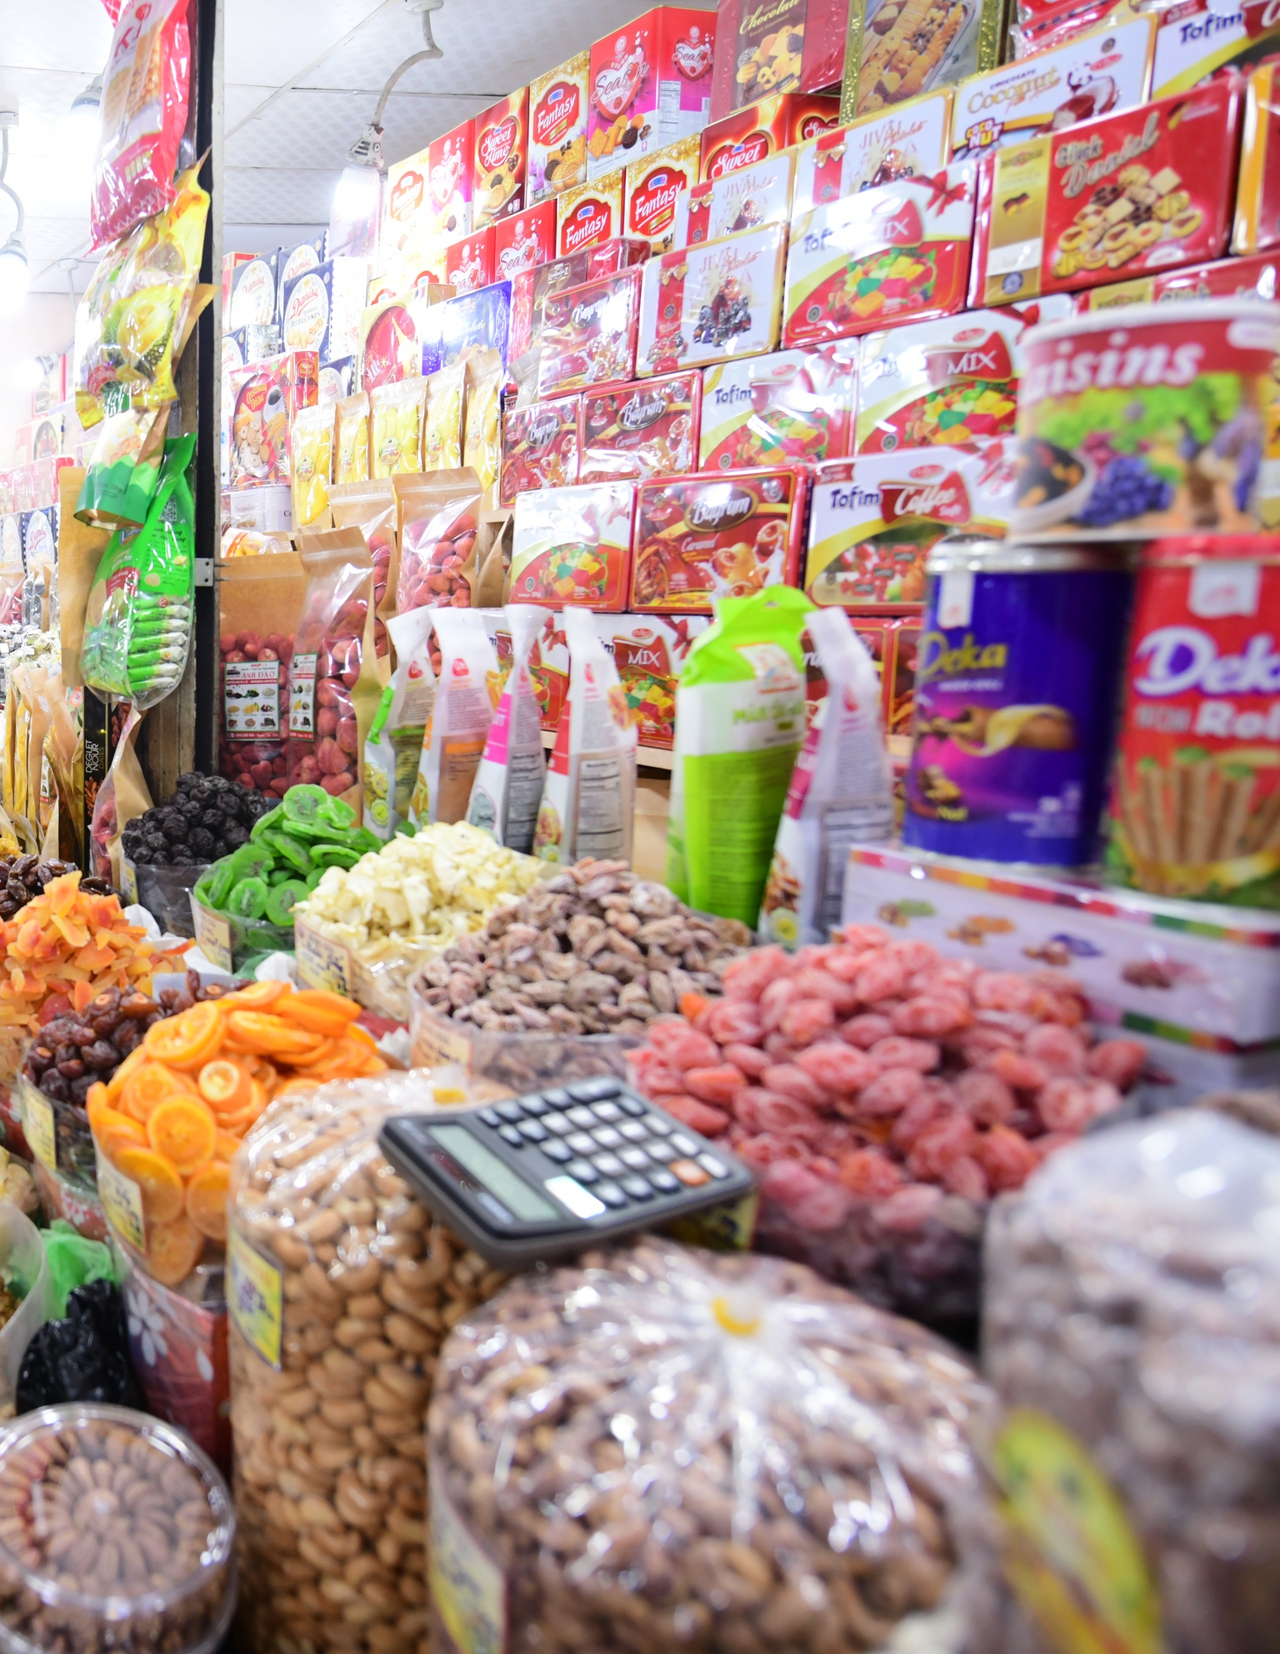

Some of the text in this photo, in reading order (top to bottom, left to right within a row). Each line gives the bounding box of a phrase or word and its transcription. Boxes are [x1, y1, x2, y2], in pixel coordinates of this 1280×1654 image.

[1180, 11, 1243, 45] Tofim
[967, 66, 1062, 115] Coconut
[990, 69, 1036, 90] CHOCOLATE
[537, 92, 577, 128] Fantasy
[482, 124, 513, 156] Sweet
[966, 119, 996, 141] COCO
[968, 123, 1005, 150] NUT
[483, 143, 511, 166] Time
[711, 143, 762, 179] Sweet
[1055, 134, 1104, 168] Glück
[635, 181, 682, 220] Fantasy
[565, 211, 609, 248] Fantasy
[804, 230, 835, 253] Tof
[292, 289, 320, 319] Danisa
[946, 350, 998, 376] MIX
[715, 384, 753, 406] Tofim
[622, 400, 665, 427] Bayram
[692, 495, 751, 525] Bayram
[831, 485, 880, 512] Tofim
[893, 482, 956, 518] Coffee
[680, 535, 720, 553] Caramel
[627, 649, 661, 668] MIX
[917, 631, 1009, 678] Deka
[1133, 625, 1280, 696] Dek
[241, 672, 256, 680] ANH
